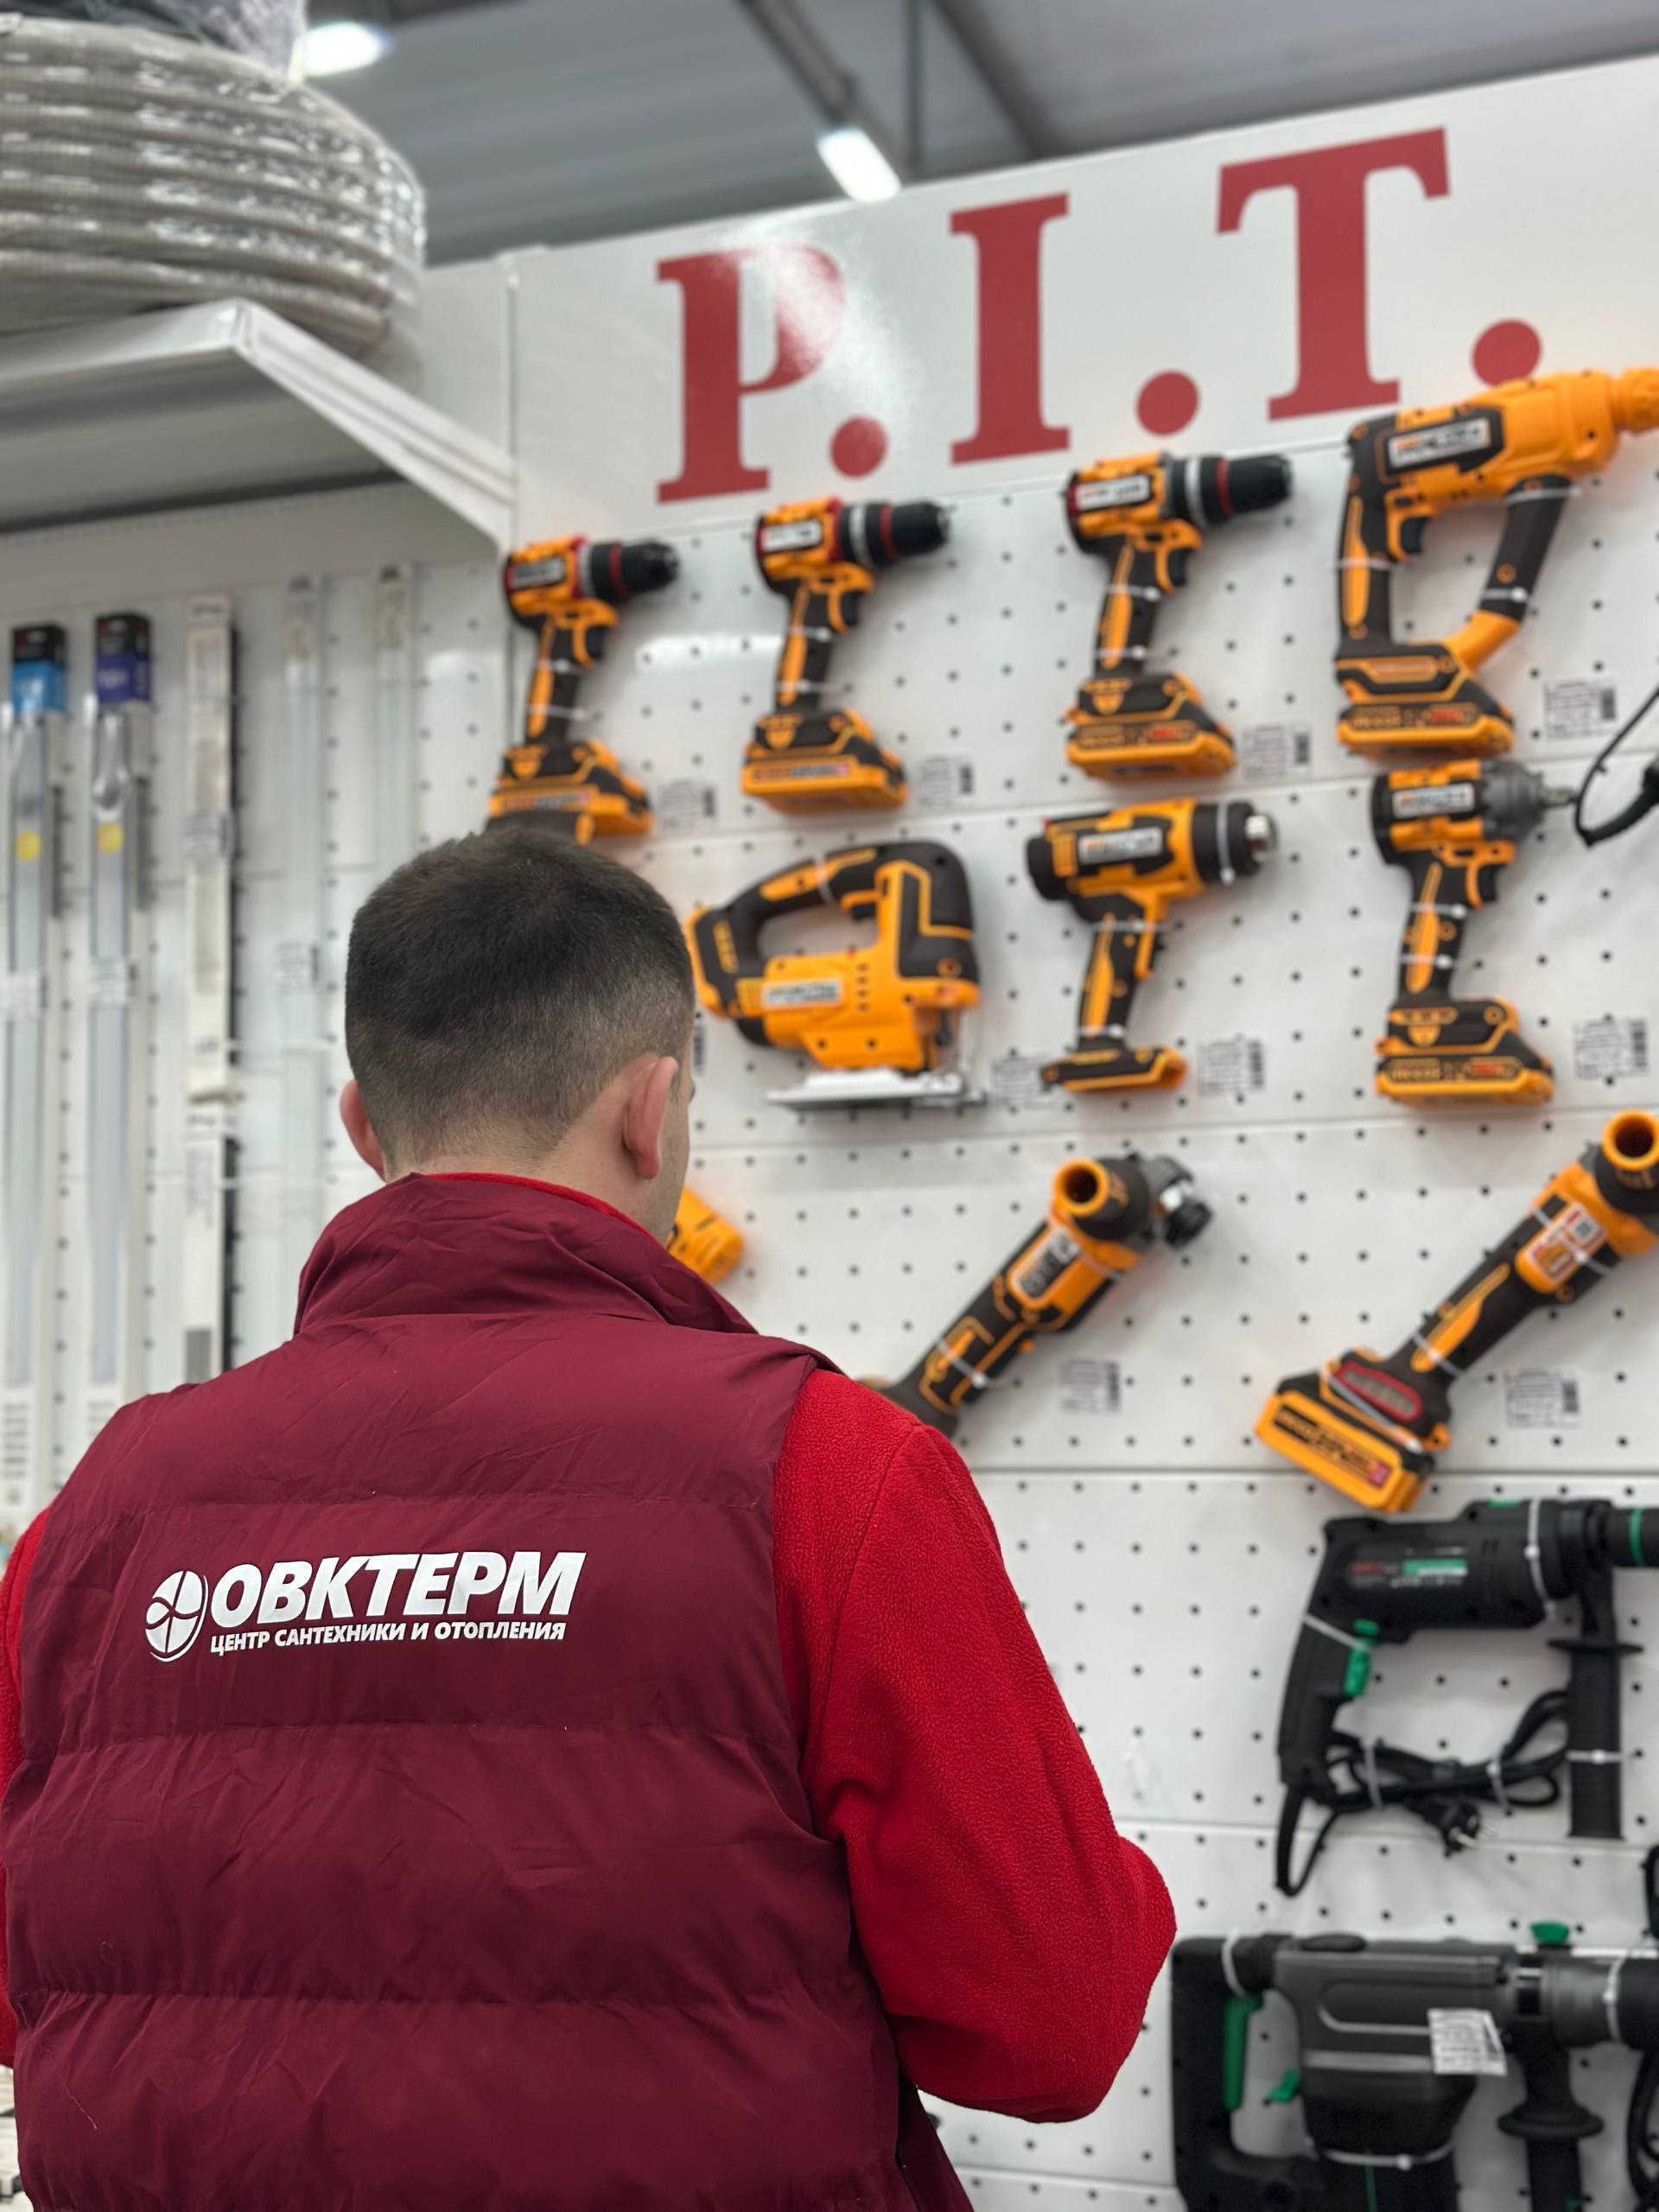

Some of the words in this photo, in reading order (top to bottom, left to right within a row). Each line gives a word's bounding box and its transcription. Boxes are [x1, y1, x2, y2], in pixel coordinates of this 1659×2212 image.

[657, 128, 1543, 505] P.I.T.
[210, 1551, 588, 1629] ОВКТЕРМ
[210, 1630, 271, 1657] ЦЕНТР
[273, 1623, 407, 1648] САНТЕХНИКИ
[410, 1622, 430, 1641] И
[434, 1621, 568, 1641] ОТОПЛЕНИЯ
